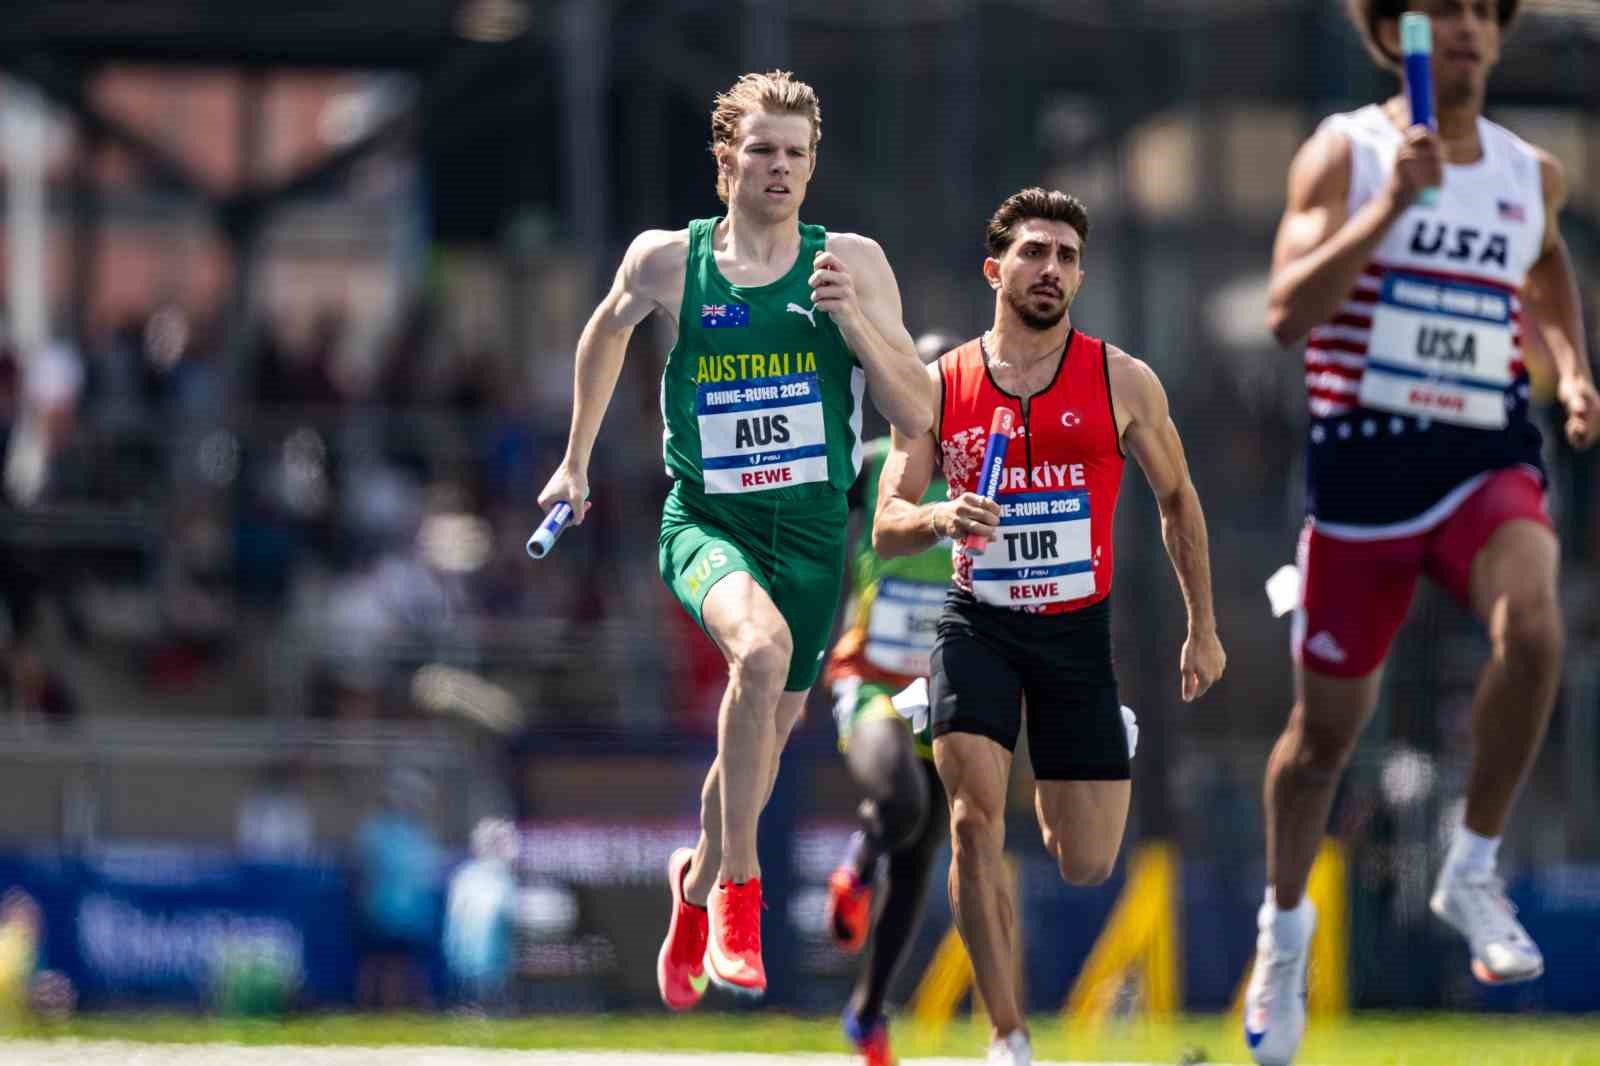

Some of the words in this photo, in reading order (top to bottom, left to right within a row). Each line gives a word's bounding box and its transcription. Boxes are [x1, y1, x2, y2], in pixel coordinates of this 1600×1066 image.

[1410, 221, 1508, 268] USA
[1416, 326, 1477, 366] USA
[696, 352, 817, 383] AUSTRALIA
[706, 385, 779, 406] RHINE-RUHR
[780, 382, 811, 398] 2025
[736, 415, 791, 449] AUS
[741, 467, 792, 487] REWE
[1050, 498, 1081, 515] 2025
[1003, 529, 1059, 562] TUR
[1010, 582, 1060, 600] REWE
